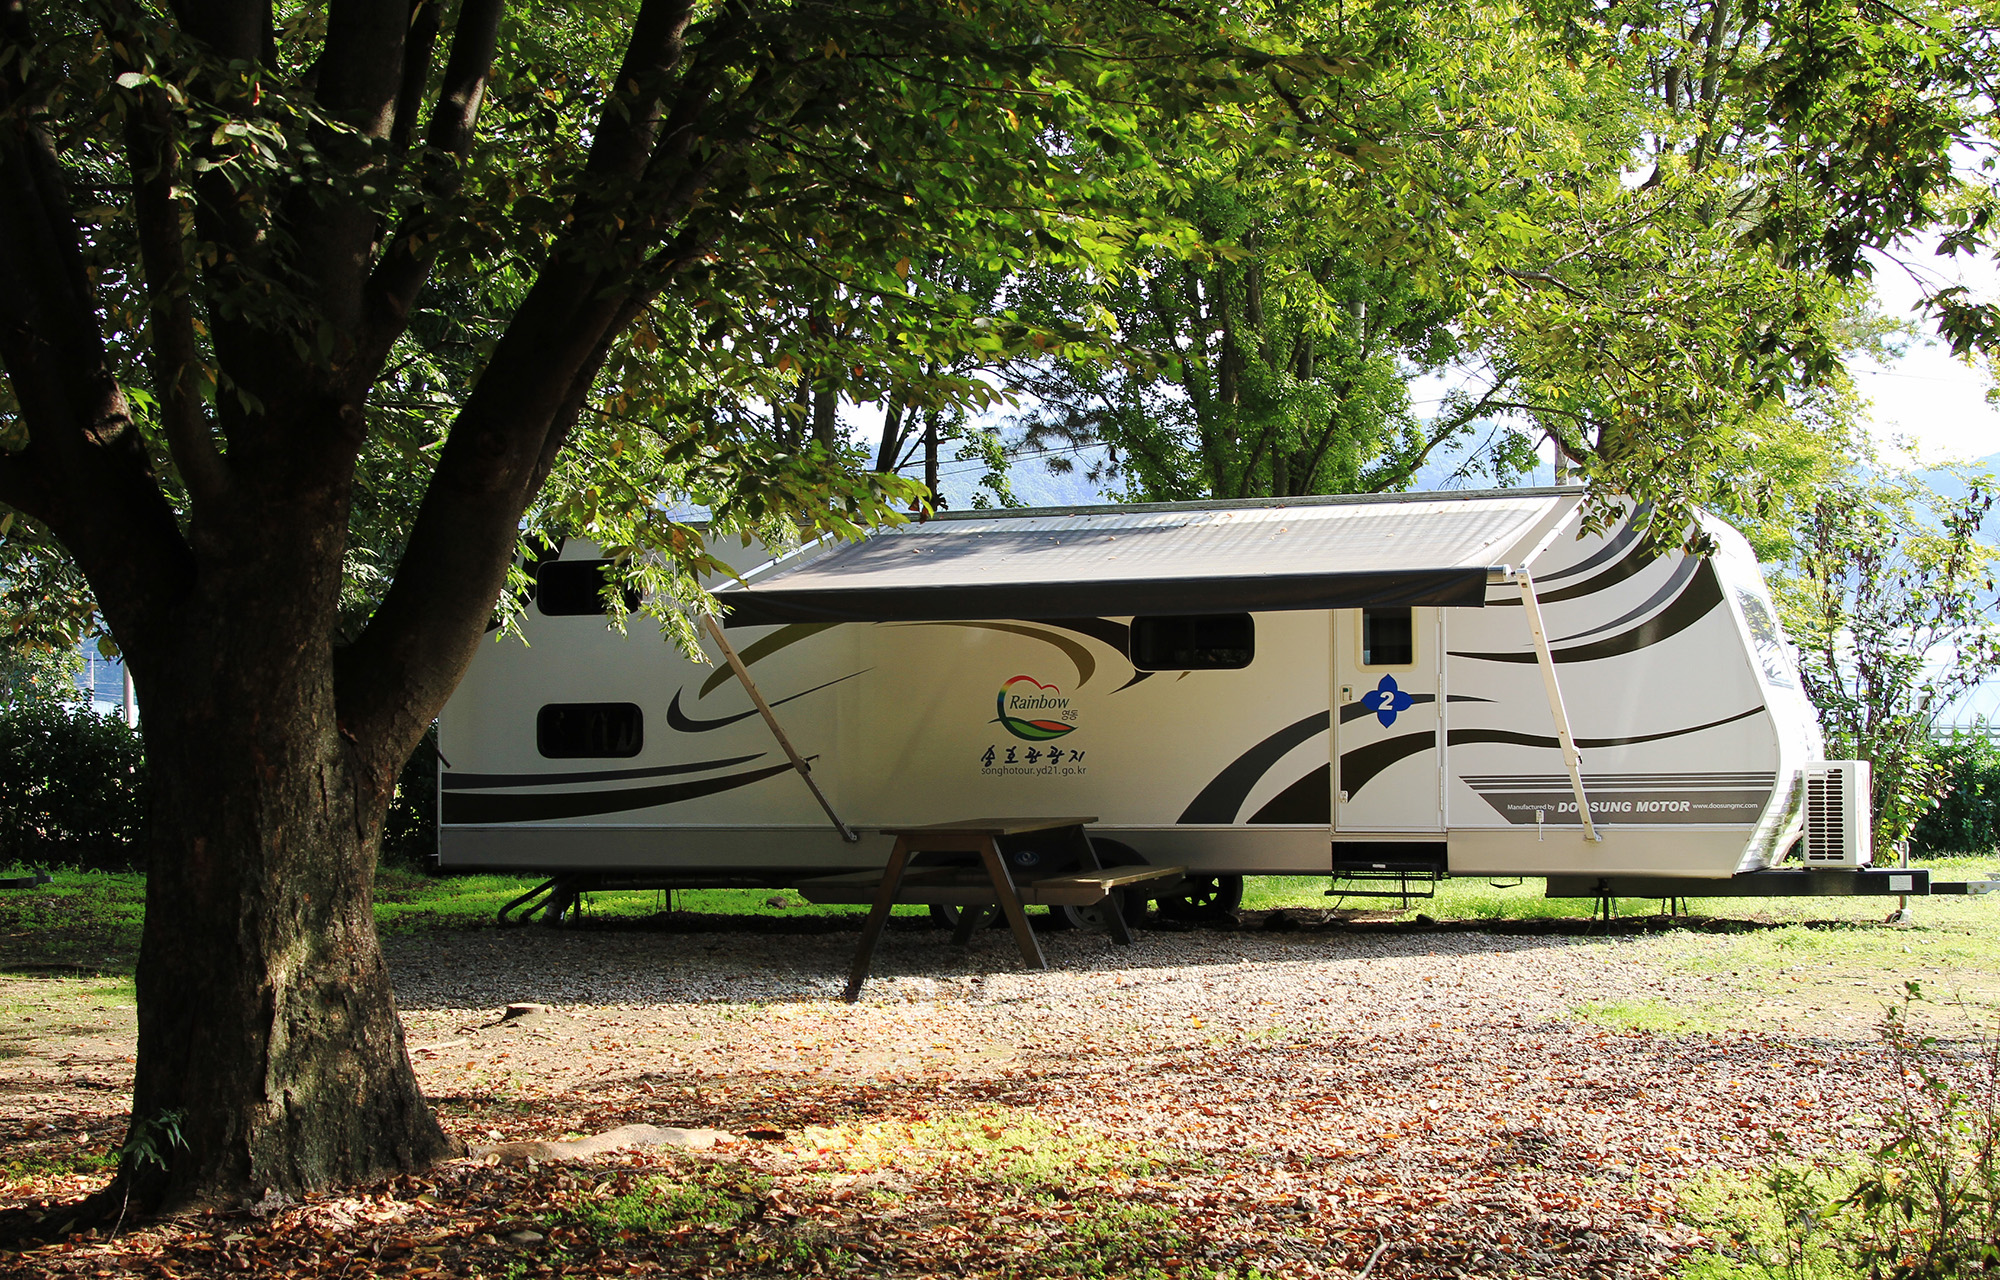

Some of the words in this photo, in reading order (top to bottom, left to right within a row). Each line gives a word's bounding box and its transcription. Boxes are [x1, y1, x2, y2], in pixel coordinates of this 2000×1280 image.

[1009, 695, 1070, 709] Rainbow
[1378, 691, 1395, 710] 2
[1061, 709, 1078, 720] 영동
[981, 766, 1086, 776] songhotour.yd21.go.kr
[1558, 802, 1632, 812] DOSUNG
[1636, 801, 1690, 812] MOTOR
